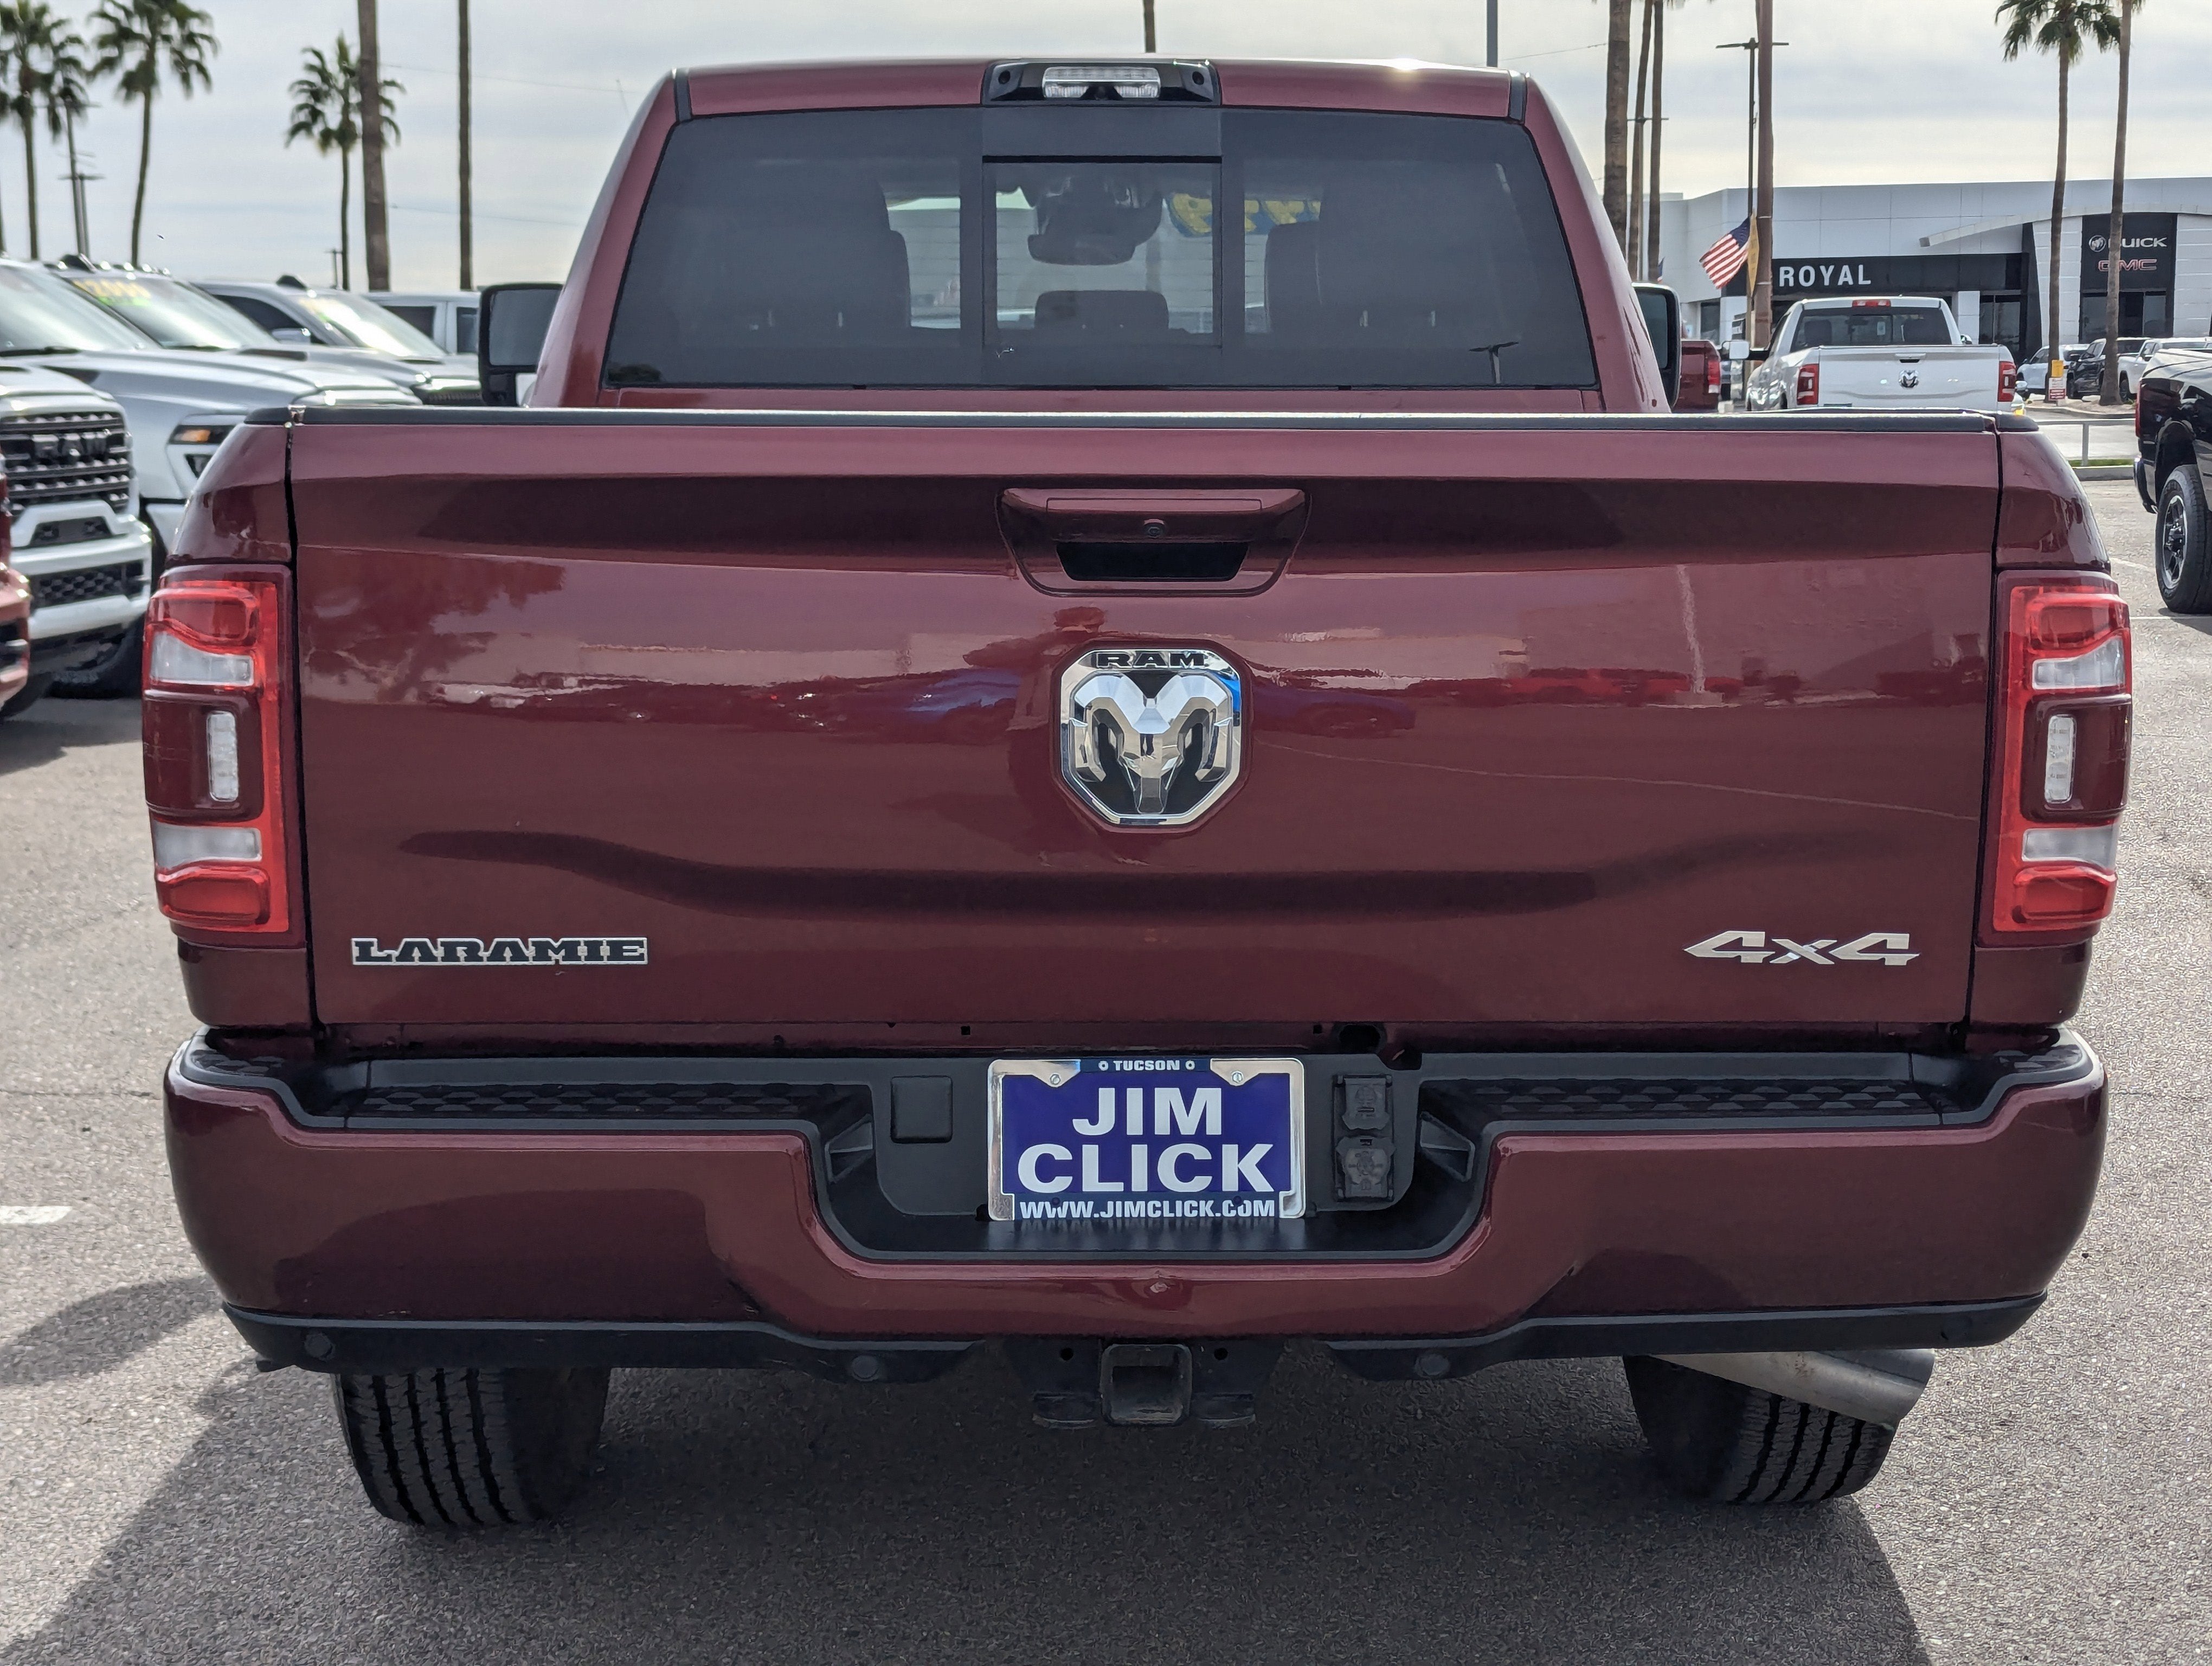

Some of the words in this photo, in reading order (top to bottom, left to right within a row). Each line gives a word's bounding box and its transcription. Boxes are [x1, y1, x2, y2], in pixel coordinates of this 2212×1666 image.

[2108, 238, 2167, 248] UICK
[1779, 264, 1871, 287] ROYAL
[1096, 652, 1205, 668] RAM
[351, 938, 648, 965] LARAMIE
[1682, 930, 1920, 966] 4x4
[1113, 1060, 1180, 1071] TUCSON
[1072, 1087, 1221, 1136] JIM
[1018, 1143, 1275, 1193] CLICK
[1020, 1200, 1275, 1219] WWW.JIMCLICK.COM
